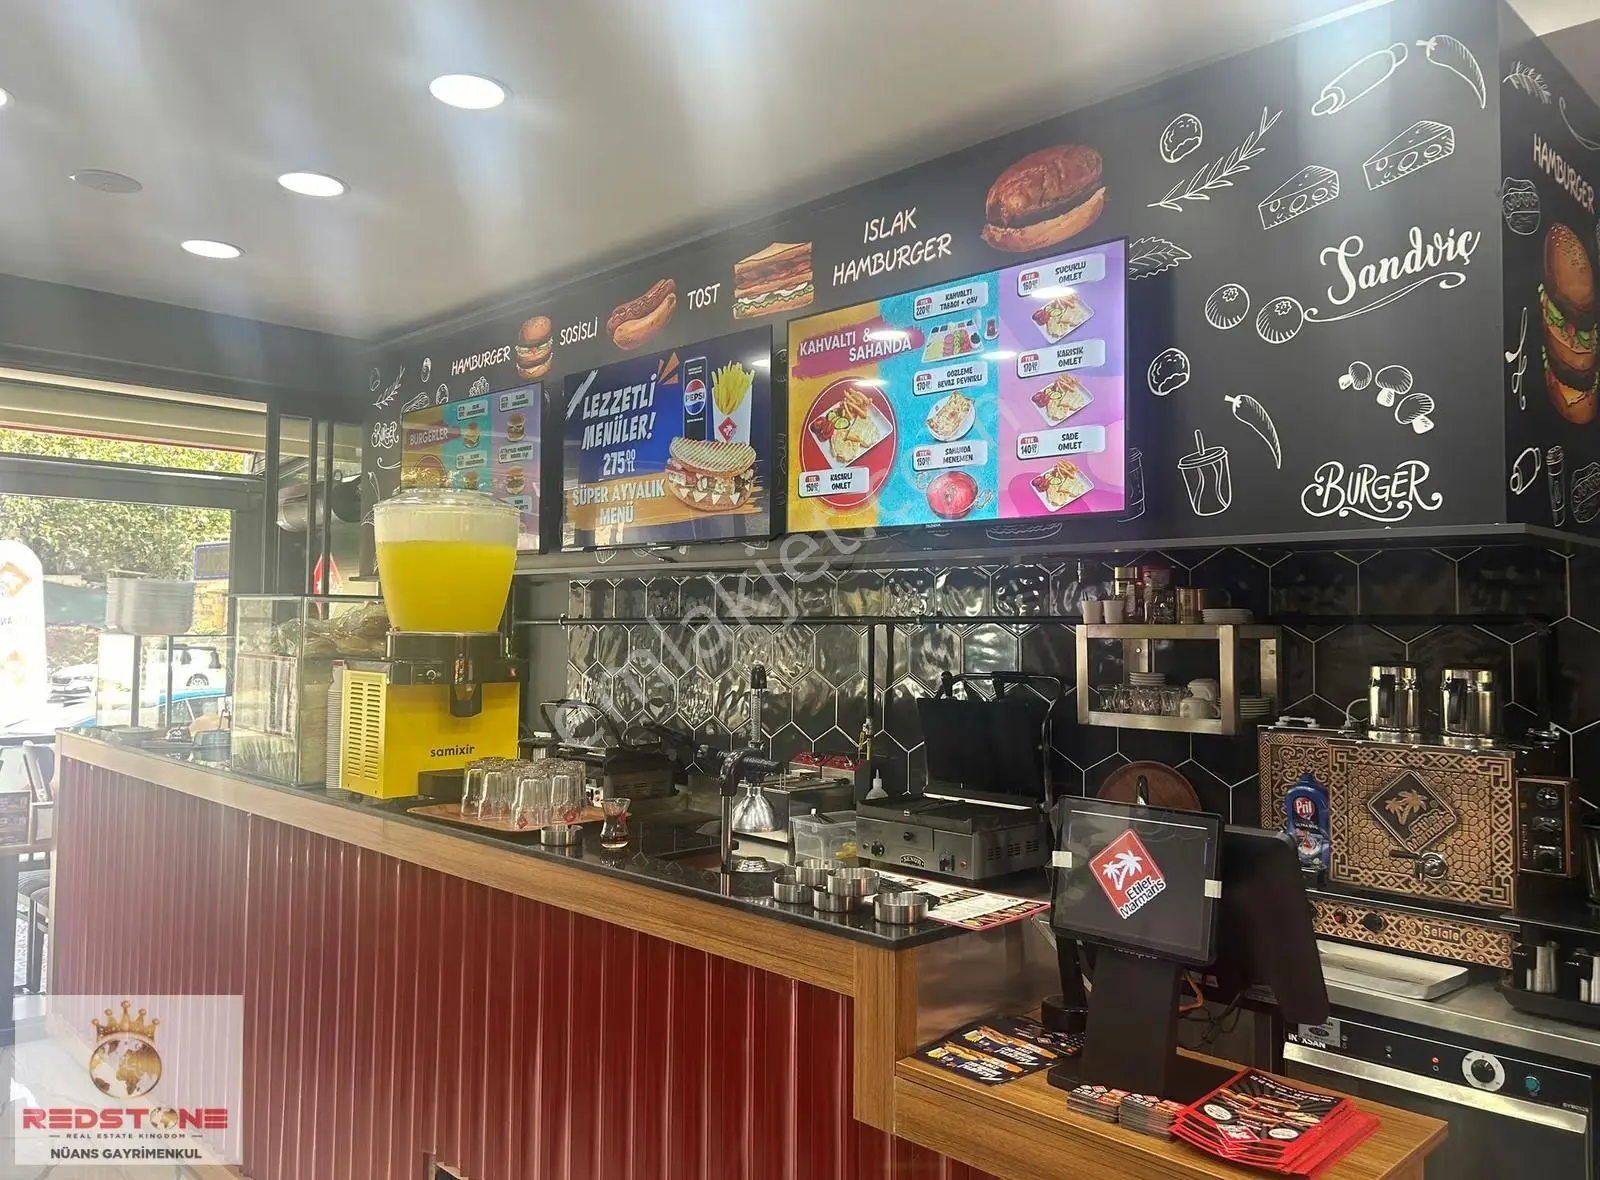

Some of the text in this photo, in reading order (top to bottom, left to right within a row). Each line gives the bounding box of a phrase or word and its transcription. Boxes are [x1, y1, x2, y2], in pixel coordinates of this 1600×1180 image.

[1533, 132, 1595, 214] HAMBURGER
[863, 207, 917, 244] ISLAK
[832, 233, 953, 287] HAMBURGER
[1055, 261, 1087, 276] SUCUKLU
[1320, 226, 1481, 305] Sandviç
[1058, 271, 1083, 284] OMLET
[687, 283, 721, 310] TOST
[559, 317, 598, 346] SOSİSLİ
[799, 330, 856, 357] KAHVALTI
[451, 345, 511, 376] HAMBURGER
[849, 335, 912, 363] SAHANDA
[1058, 356, 1083, 367] OMLET
[583, 373, 657, 420] LEZZETLİ
[371, 420, 400, 449] BURGER
[581, 411, 657, 450] MENÜLER!
[1061, 432, 1079, 441] SADE
[1020, 444, 1032, 455] 140
[1057, 441, 1083, 451] OMLET
[603, 450, 627, 476] 275
[572, 479, 666, 507] SÜPER AYVALIK
[831, 481, 851, 490] OMLET
[1301, 460, 1443, 521] BURGER
[599, 502, 635, 526] MENÜ
[429, 744, 476, 758] samixir
[1296, 800, 1312, 814] Pril
[1119, 880, 1165, 918] Marmaris
[1423, 924, 1459, 941] Şelale
